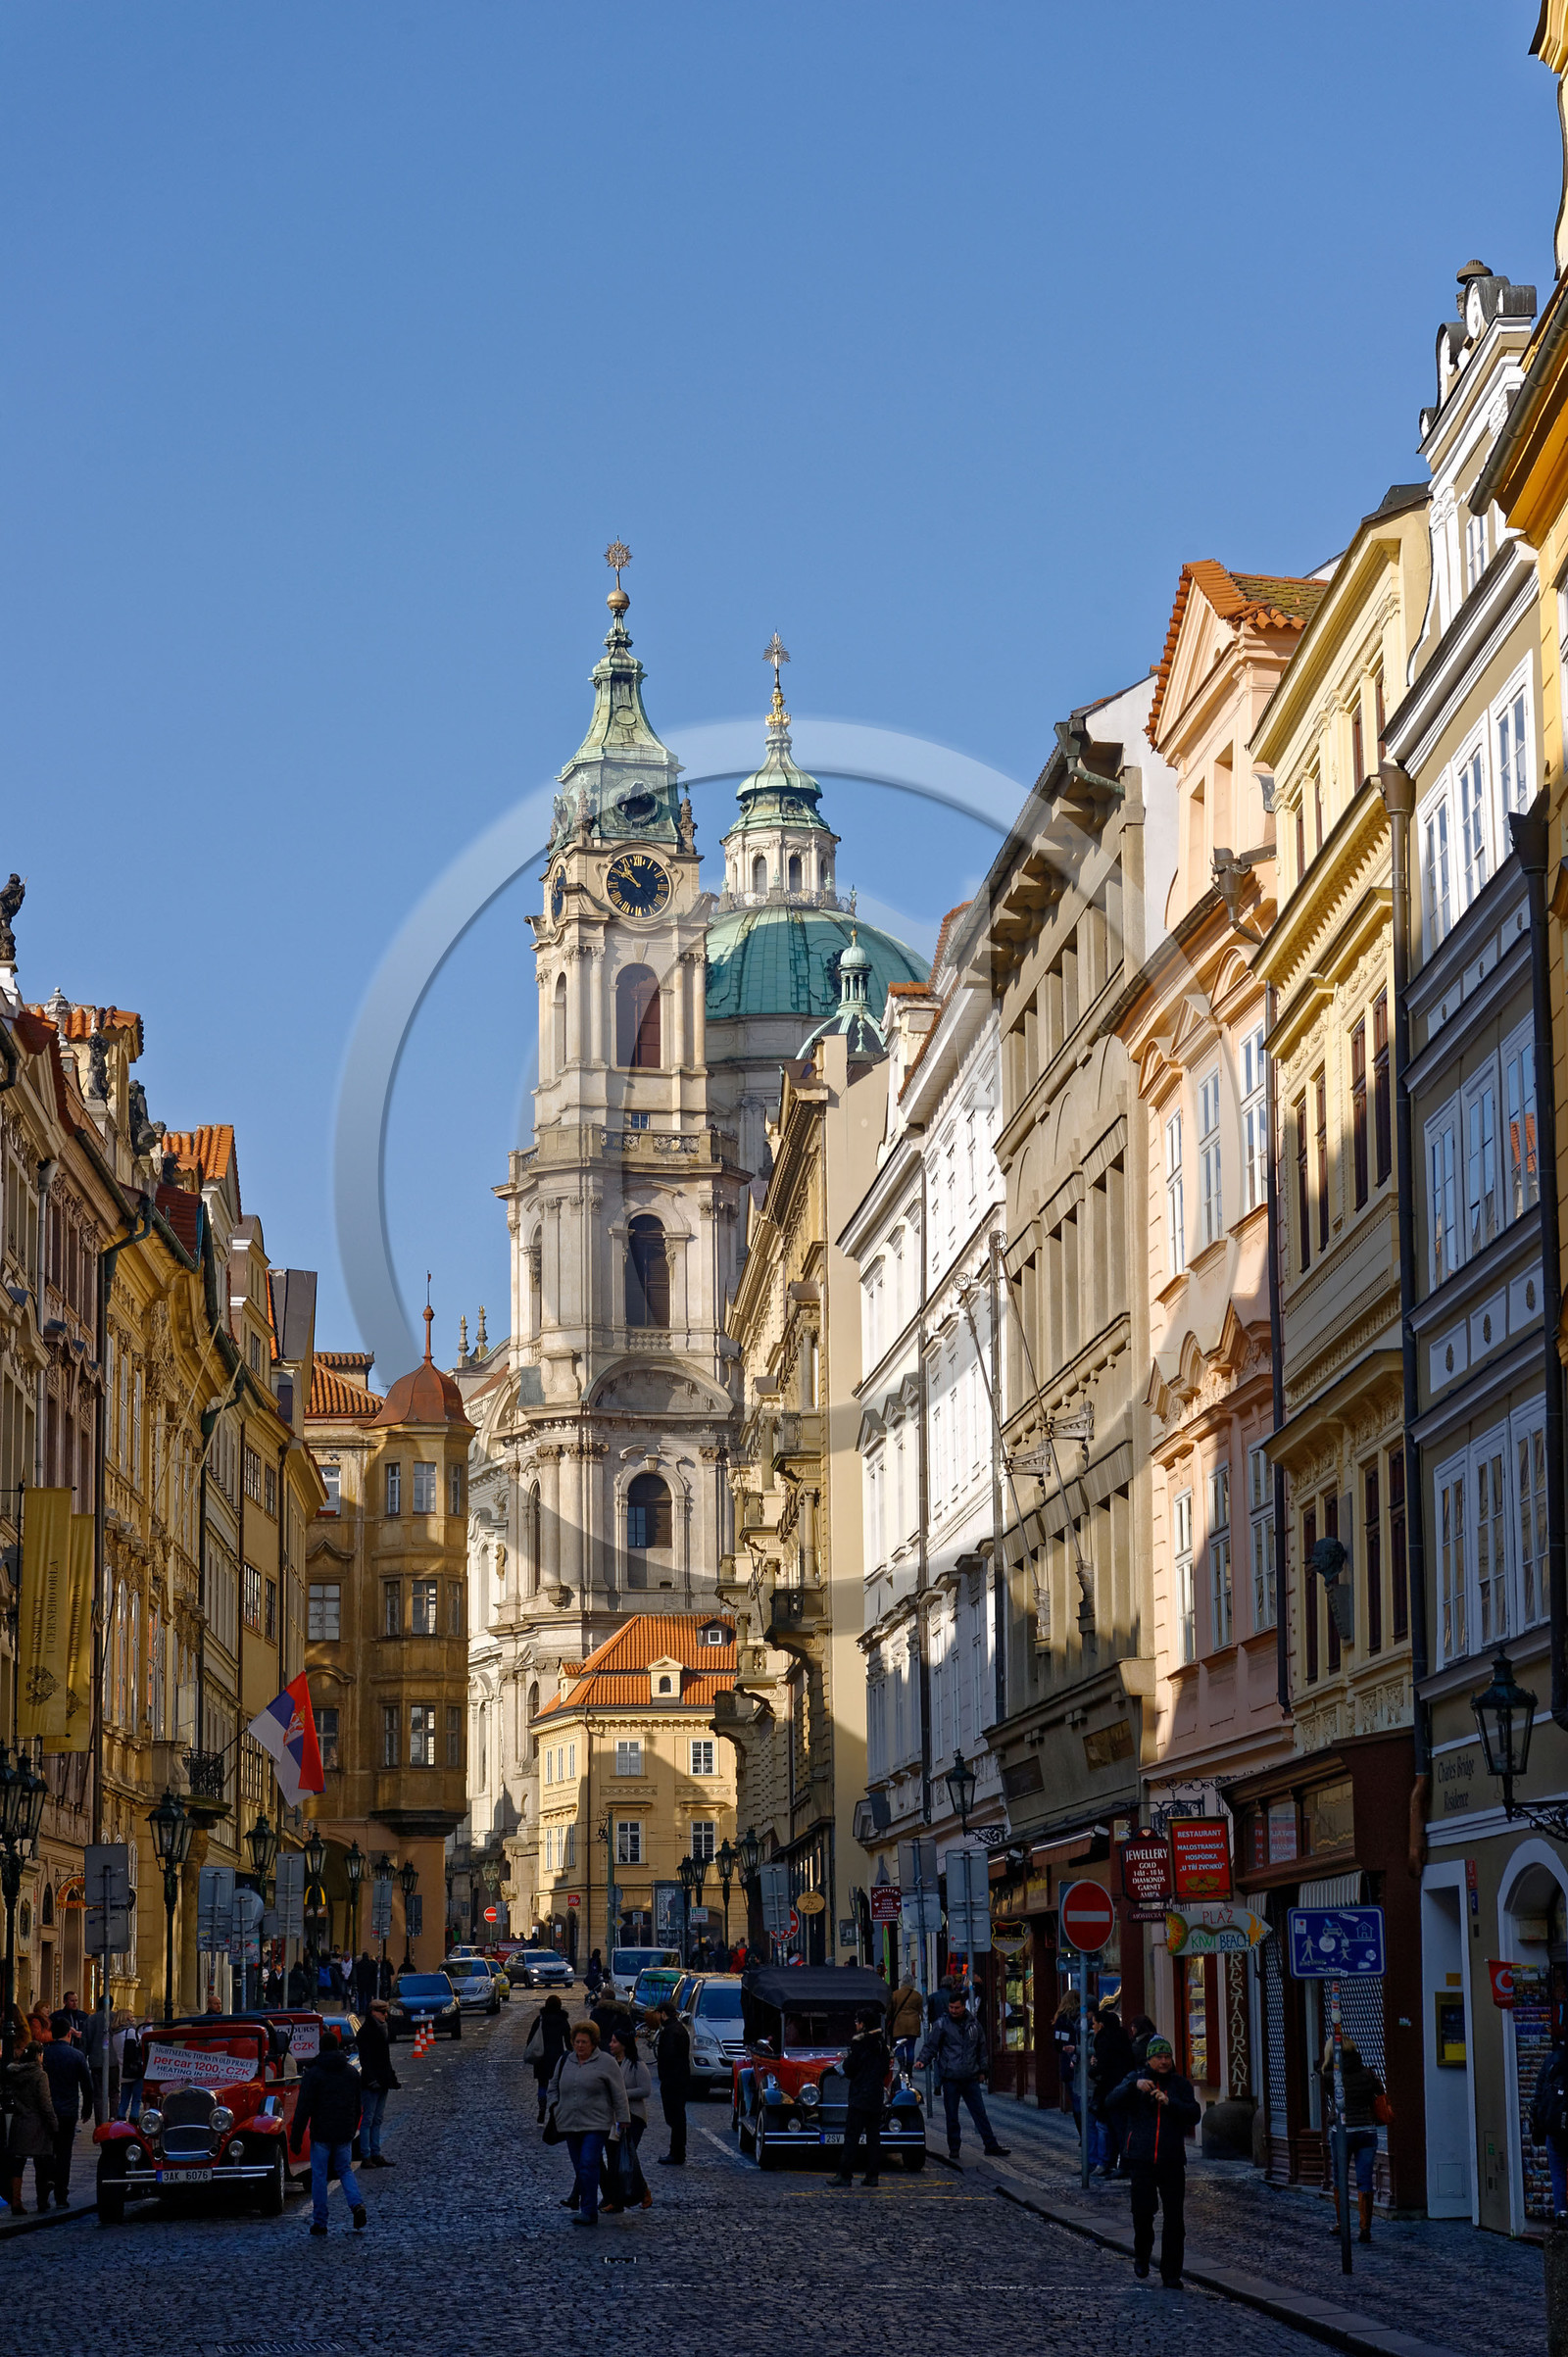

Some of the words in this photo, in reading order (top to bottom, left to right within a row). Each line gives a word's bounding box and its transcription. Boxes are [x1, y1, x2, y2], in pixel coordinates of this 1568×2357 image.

[48, 1560, 58, 1590] ORLA
[32, 1596, 42, 1653] RESIDENCE
[1438, 1759, 1456, 1783] Charles
[1457, 1753, 1474, 1781] Bridge
[1445, 1789, 1468, 1811] Residence
[1177, 1829, 1222, 1838] RESTAURANT
[1177, 1841, 1225, 1850] MALOSTRANSKÁ
[1125, 1848, 1168, 1862] JEWELLERY
[1219, 1935, 1250, 1949] BEACH
[1229, 1952, 1248, 2096] RESTAURANT
[294, 2041, 315, 2051] CZK
[155, 2046, 192, 2058] SIGHTSEEING
[193, 2052, 212, 2061] TOURS
[231, 2059, 254, 2068] PRAGUE
[154, 2056, 172, 2065] per
[173, 2059, 192, 2068] car
[226, 2066, 251, 2076] CZK
[157, 2065, 192, 2076] HEATING
[826, 2135, 841, 2143] 2SV
[164, 2171, 179, 2182] 3AK
[186, 2170, 209, 2180] 6076
